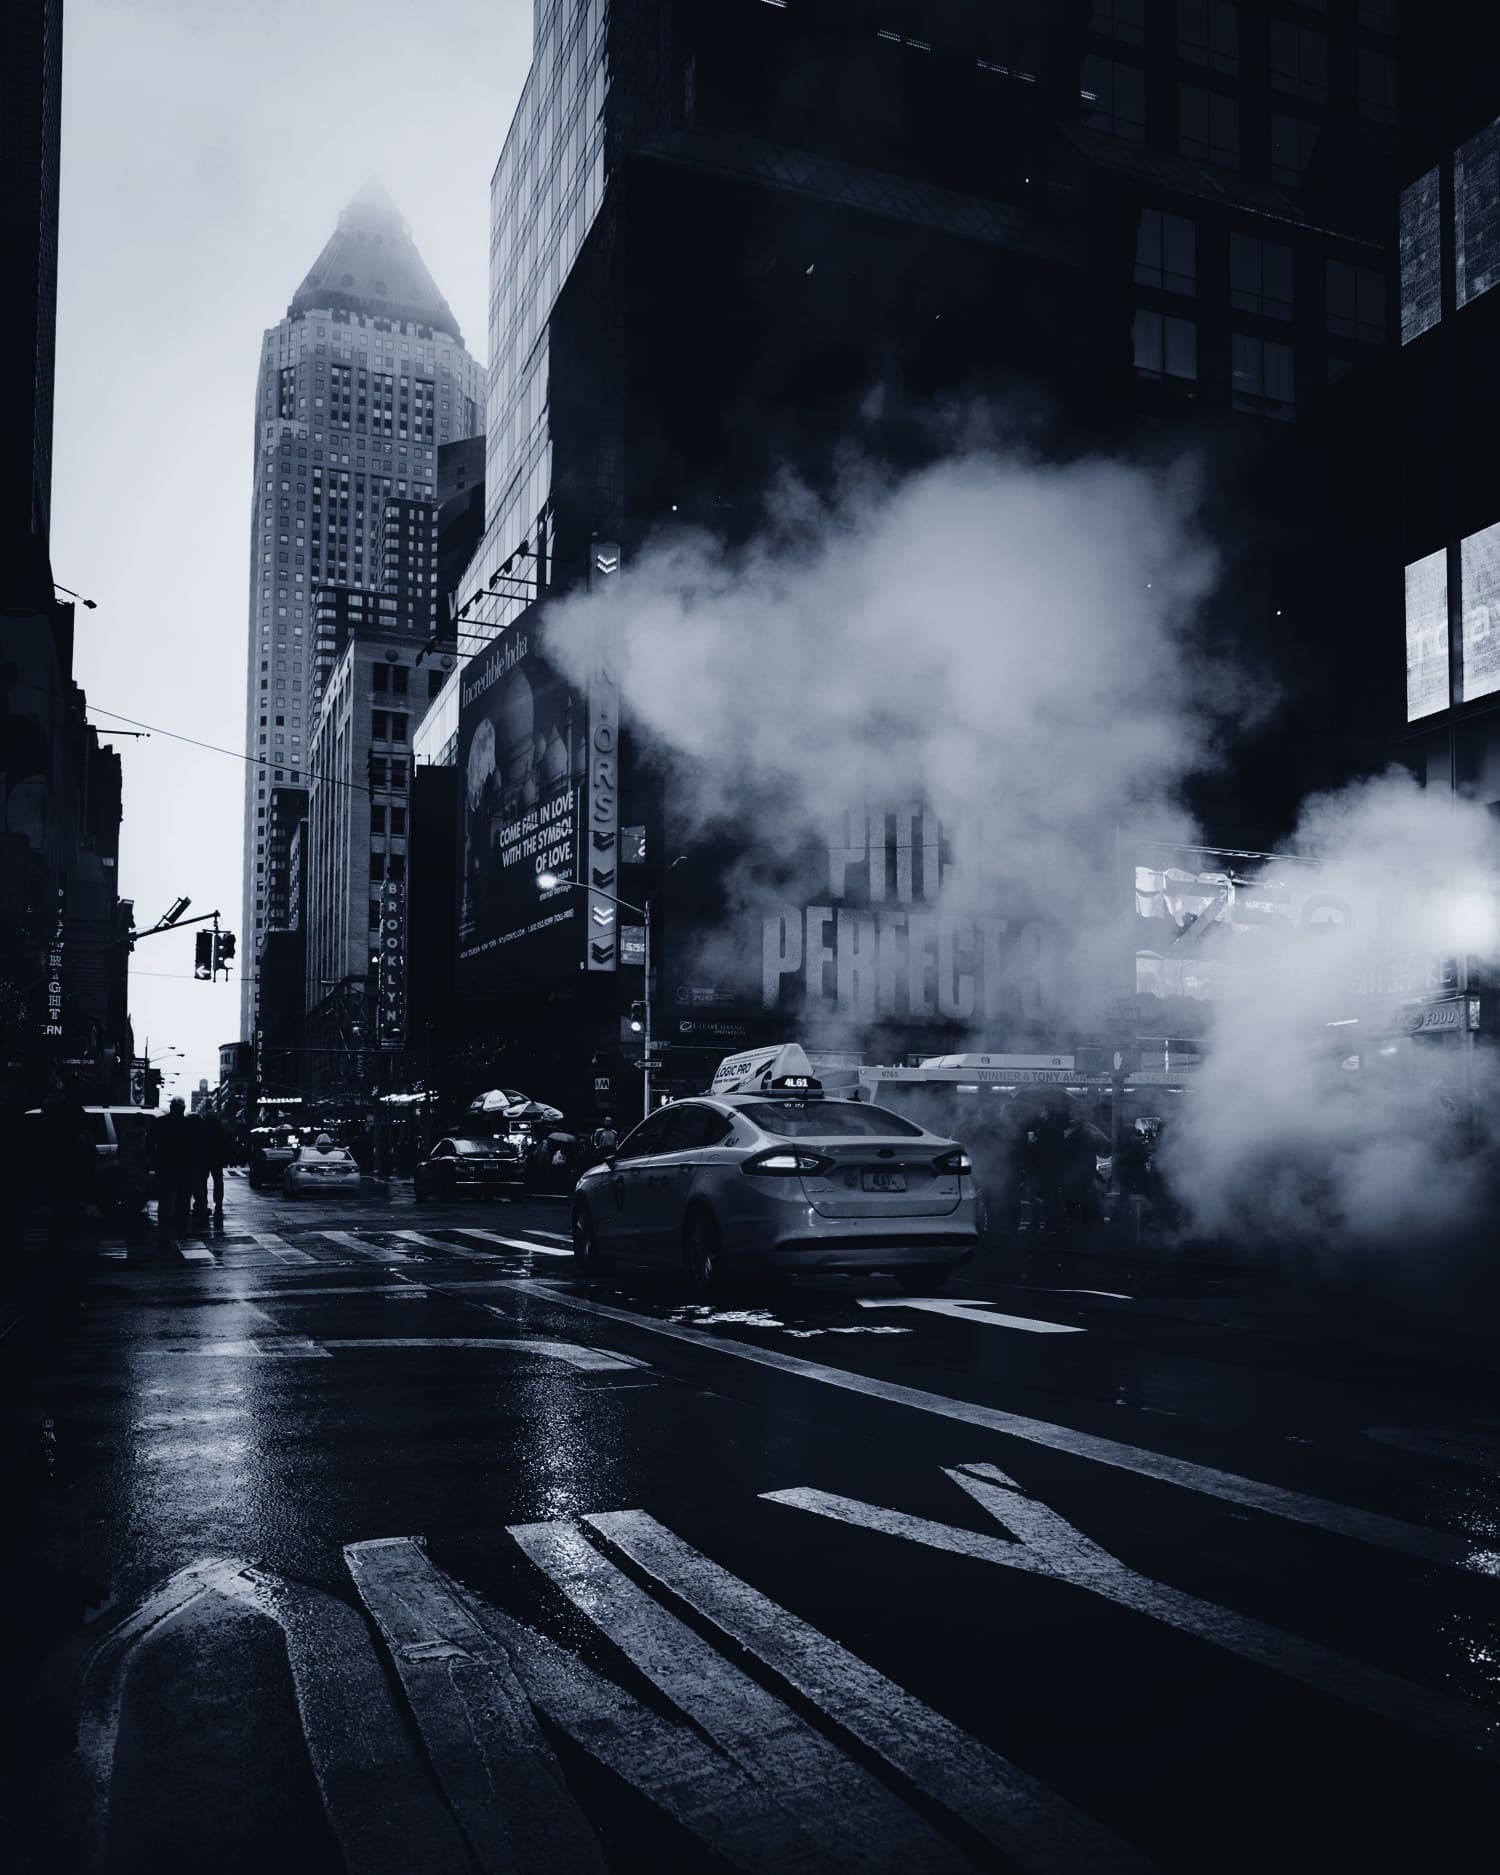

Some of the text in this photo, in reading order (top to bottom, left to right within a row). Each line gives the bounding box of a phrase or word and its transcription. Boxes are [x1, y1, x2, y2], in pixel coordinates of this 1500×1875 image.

[499, 789, 574, 848] COME FALL IN LOVE
[502, 816, 574, 868] WITH THE SYMBOL
[535, 840, 573, 875] OF LOVE.
[386, 883, 398, 1021] BROOKLYN
[761, 904, 1006, 1020] PERFECT
[715, 1062, 752, 1079] LOGIC PRO
[977, 1071, 1021, 1081] WINNER
[1032, 1071, 1062, 1081] TONY
